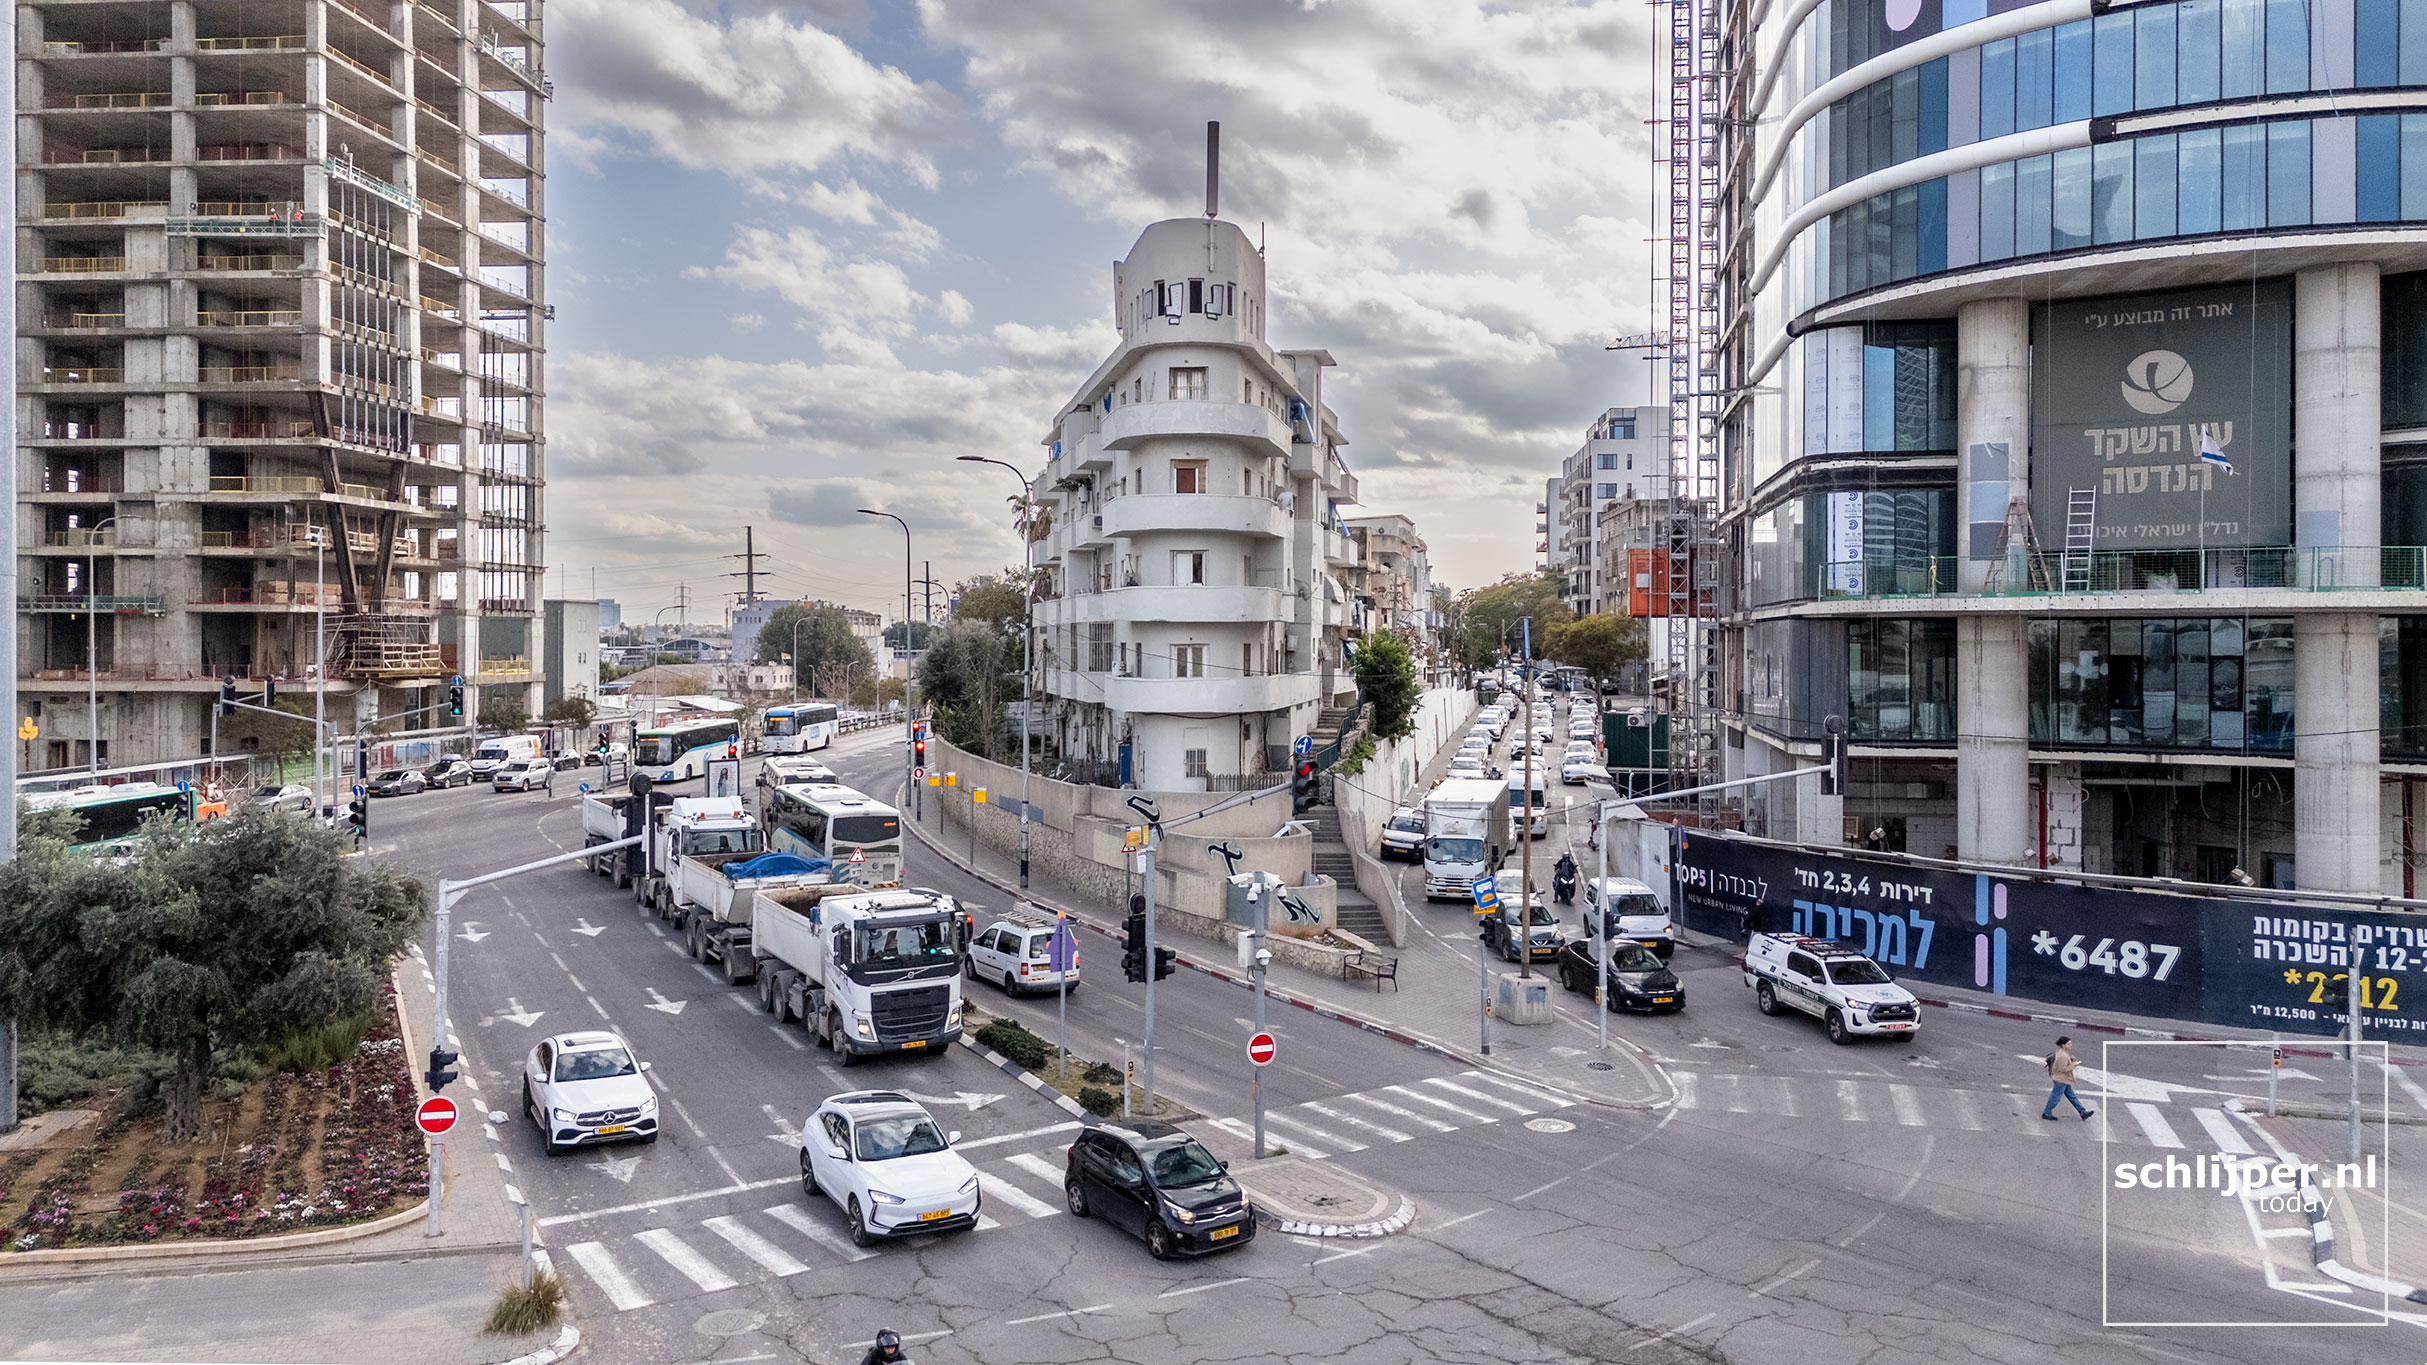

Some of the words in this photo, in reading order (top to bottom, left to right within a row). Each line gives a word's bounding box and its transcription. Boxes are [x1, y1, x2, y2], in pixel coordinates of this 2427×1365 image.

[2114, 309, 2165, 326] מבוצע
[2171, 306, 2190, 320] זה
[2197, 302, 2233, 317] אתר
[2084, 313, 2108, 328] ע"י
[2084, 424, 2181, 461] השקד
[2102, 463, 2213, 495] הנדסה
[2133, 523, 2191, 537] ישראלי
[1675, 863, 1706, 887] TOP5
[1719, 873, 1768, 899] לבנדה
[1794, 867, 1819, 888] חד'
[1823, 870, 1870, 896] 2,3,4
[1880, 881, 1933, 904] דירות
[1688, 894, 1701, 904] NEW
[1703, 898, 1724, 910] URBAN
[1725, 903, 1749, 915] LIVING
[1792, 899, 1936, 969] למכירה
[2253, 916, 2346, 943] בקומות
[2283, 968, 2398, 1010] 212
[2274, 1006, 2316, 1020] 12,500
[2375, 1017, 2407, 1028] לבניין
